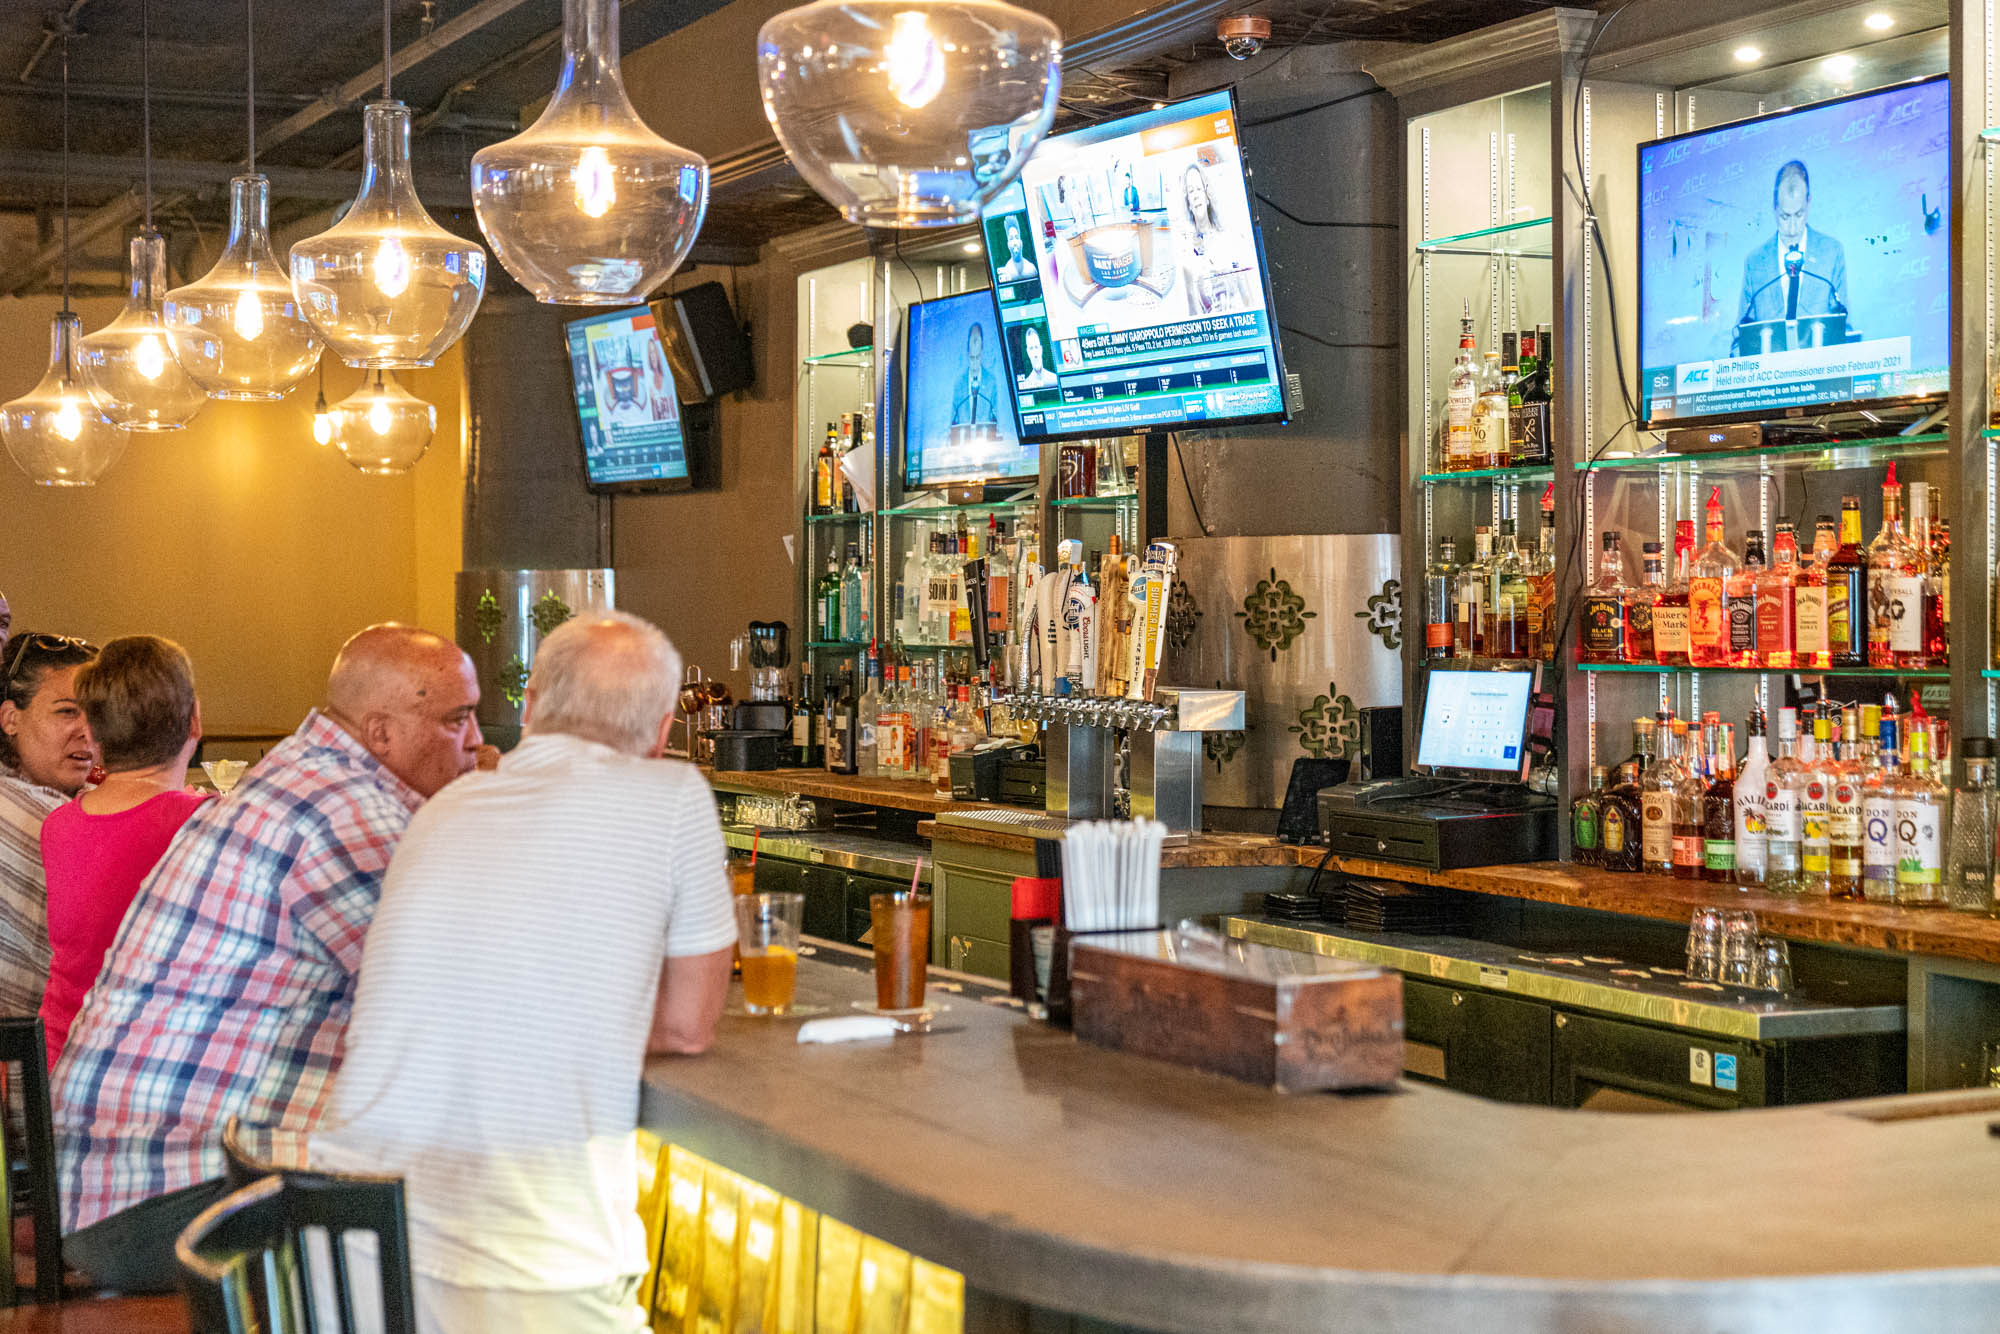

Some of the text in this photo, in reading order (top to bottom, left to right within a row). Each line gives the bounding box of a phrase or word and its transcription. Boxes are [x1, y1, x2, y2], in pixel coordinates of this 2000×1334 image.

[1082, 338, 1097, 349] 49ers
[1097, 335, 1110, 347] GIVE
[1111, 332, 1128, 345] JIMMY
[1129, 327, 1164, 343] GAROPPOLO
[1164, 323, 1201, 338] PERMISSION
[1201, 320, 1212, 332] TO
[1212, 317, 1228, 330] SEEK
[1234, 314, 1256, 326] TRADE
[1716, 360, 1759, 374] Jim Phillips
[1716, 356, 1901, 386] Held role of ACC Commissioner since February 2021
[1654, 375, 1669, 387] SC
[1683, 369, 1709, 383] ACC
[1147, 587, 1160, 643] SUMMER ALE
[1654, 611, 1687, 619] Maker's
[1663, 620, 1687, 629] Mark
[1866, 809, 1889, 817] DON
[1897, 810, 1918, 818] DON
[1868, 818, 1888, 846] Q
[1898, 819, 1918, 846] Q
